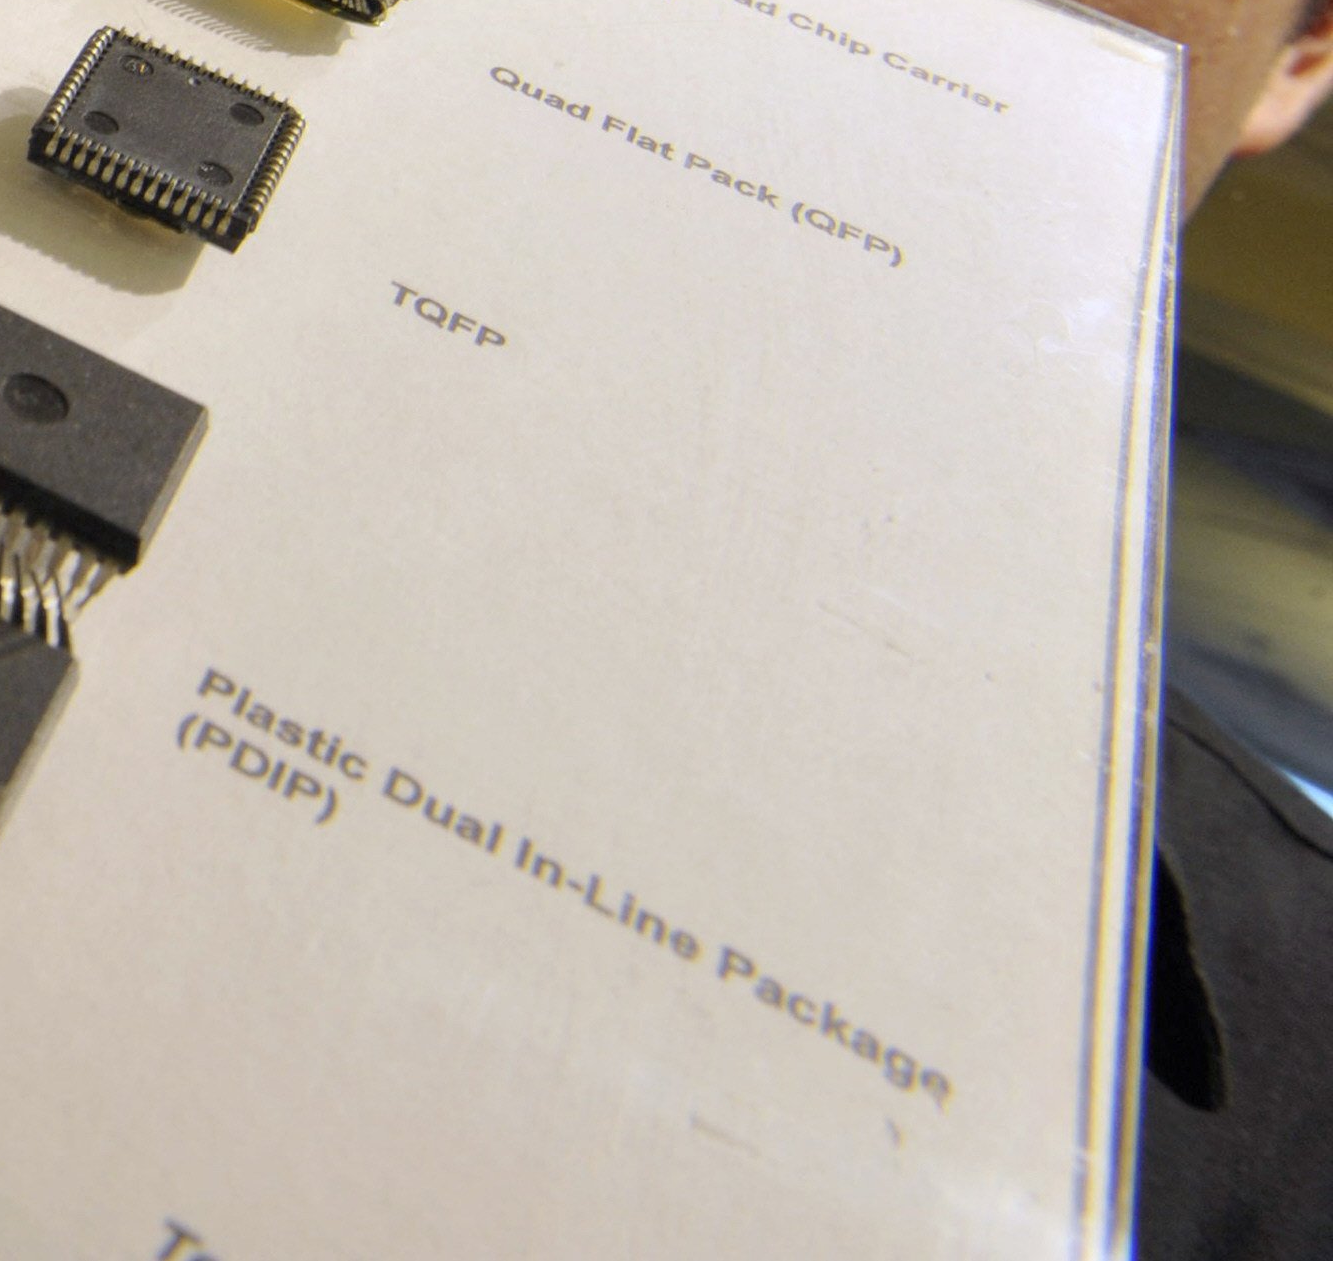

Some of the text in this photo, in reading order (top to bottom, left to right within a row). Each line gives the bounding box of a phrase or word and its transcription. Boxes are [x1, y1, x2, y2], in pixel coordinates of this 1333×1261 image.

[787, 11, 873, 59] Chip
[880, 50, 1013, 116] Carrier
[488, 64, 906, 269] Quad Flat Pack (QFP)
[389, 280, 509, 350] TQFP
[174, 712, 342, 827] (PDIP)
[195, 667, 955, 1106] Plastic Dual In-Line Package
